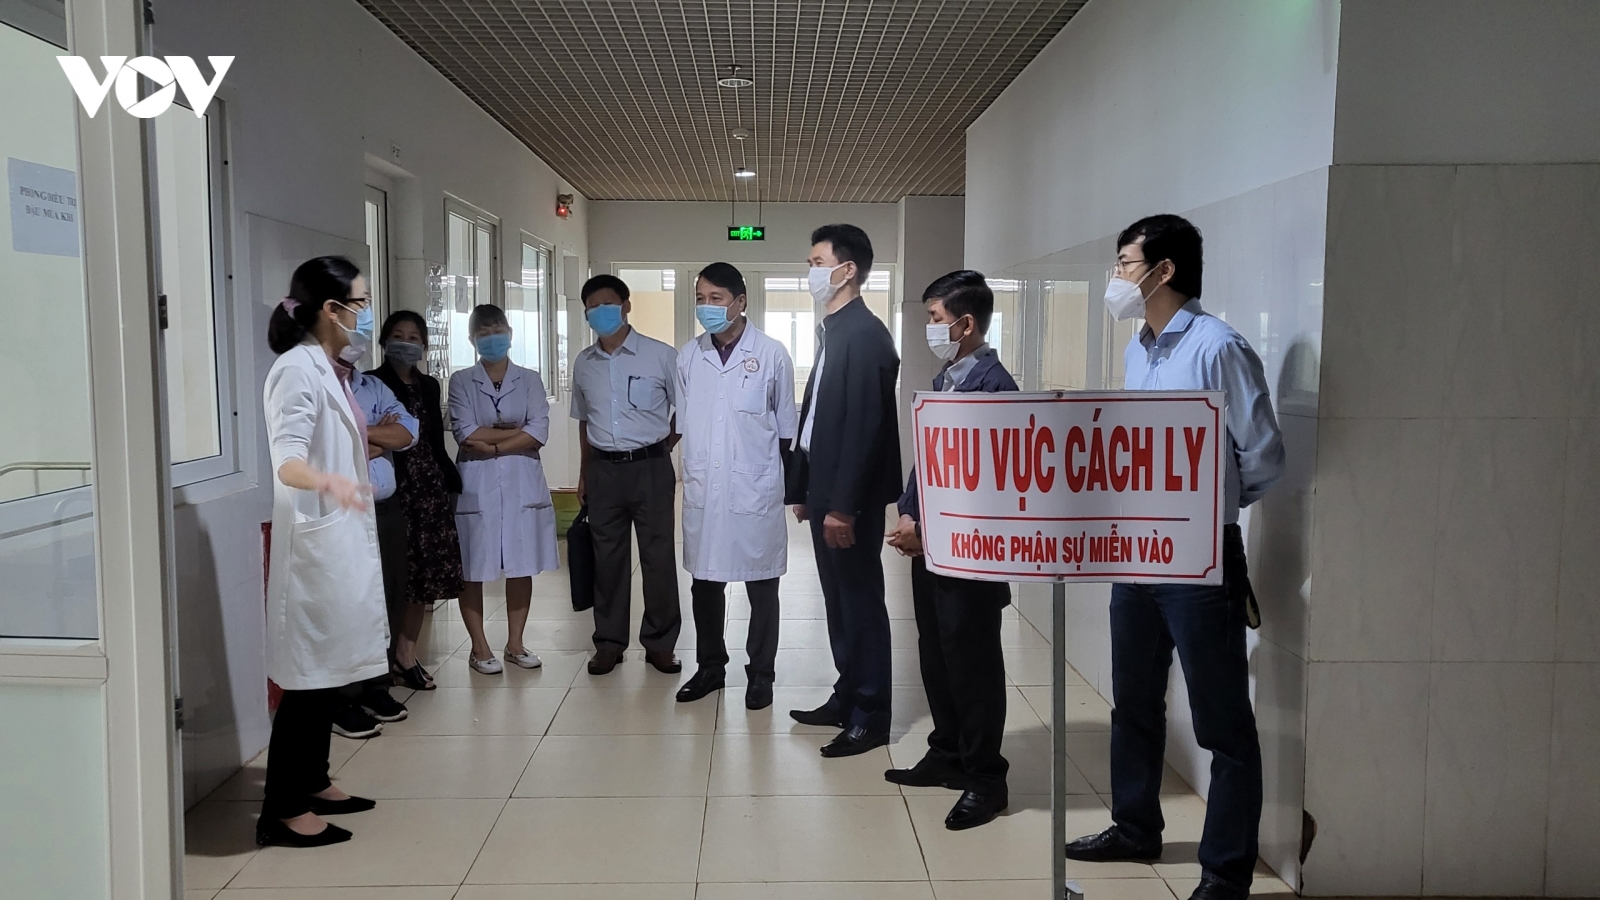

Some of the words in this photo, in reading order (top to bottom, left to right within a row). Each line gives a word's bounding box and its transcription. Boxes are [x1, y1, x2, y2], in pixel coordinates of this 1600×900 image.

[924, 427, 980, 492] KHU
[990, 413, 1056, 511] VỰC
[1064, 408, 1154, 493] CÁCH
[1165, 426, 1207, 492] LY
[951, 528, 1005, 562] KHÔNG
[1010, 530, 1057, 571] PHẬN
[1062, 531, 1086, 571] SỰ
[1089, 523, 1132, 563] MIỄN
[1137, 529, 1174, 564] VÀO
